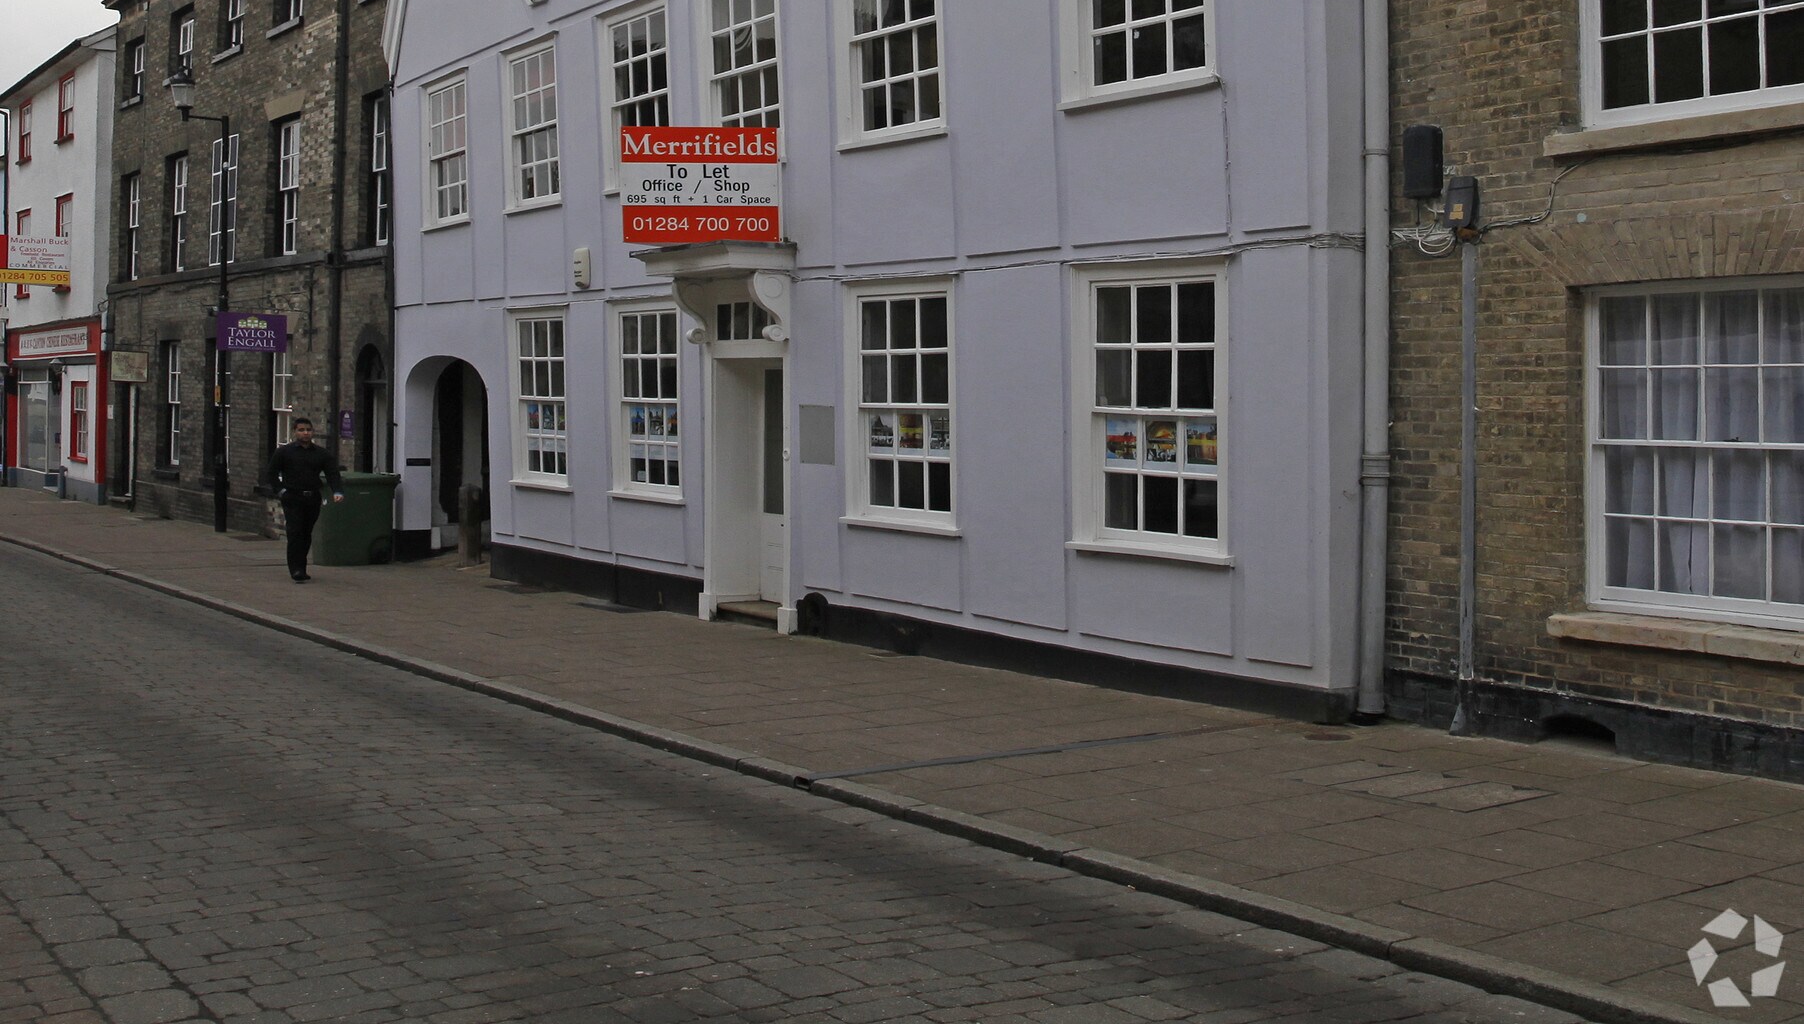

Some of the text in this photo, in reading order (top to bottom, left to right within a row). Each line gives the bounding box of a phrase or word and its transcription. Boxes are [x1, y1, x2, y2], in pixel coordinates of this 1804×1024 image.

[622, 133, 776, 156] Merrifields
[667, 164, 730, 179] To Let
[642, 179, 750, 194] Office / Shop
[627, 195, 647, 203] 695
[654, 196, 666, 205] sq
[673, 195, 681, 203] ft
[703, 195, 708, 203] 1
[716, 195, 733, 203] Car
[740, 195, 771, 205] Space
[632, 217, 769, 232] 01284 700 700
[10, 237, 46, 245] Marshall
[0, 272, 69, 282] 1284 705 505
[228, 327, 276, 338] TAYLOR
[228, 337, 276, 348] ENGALL
